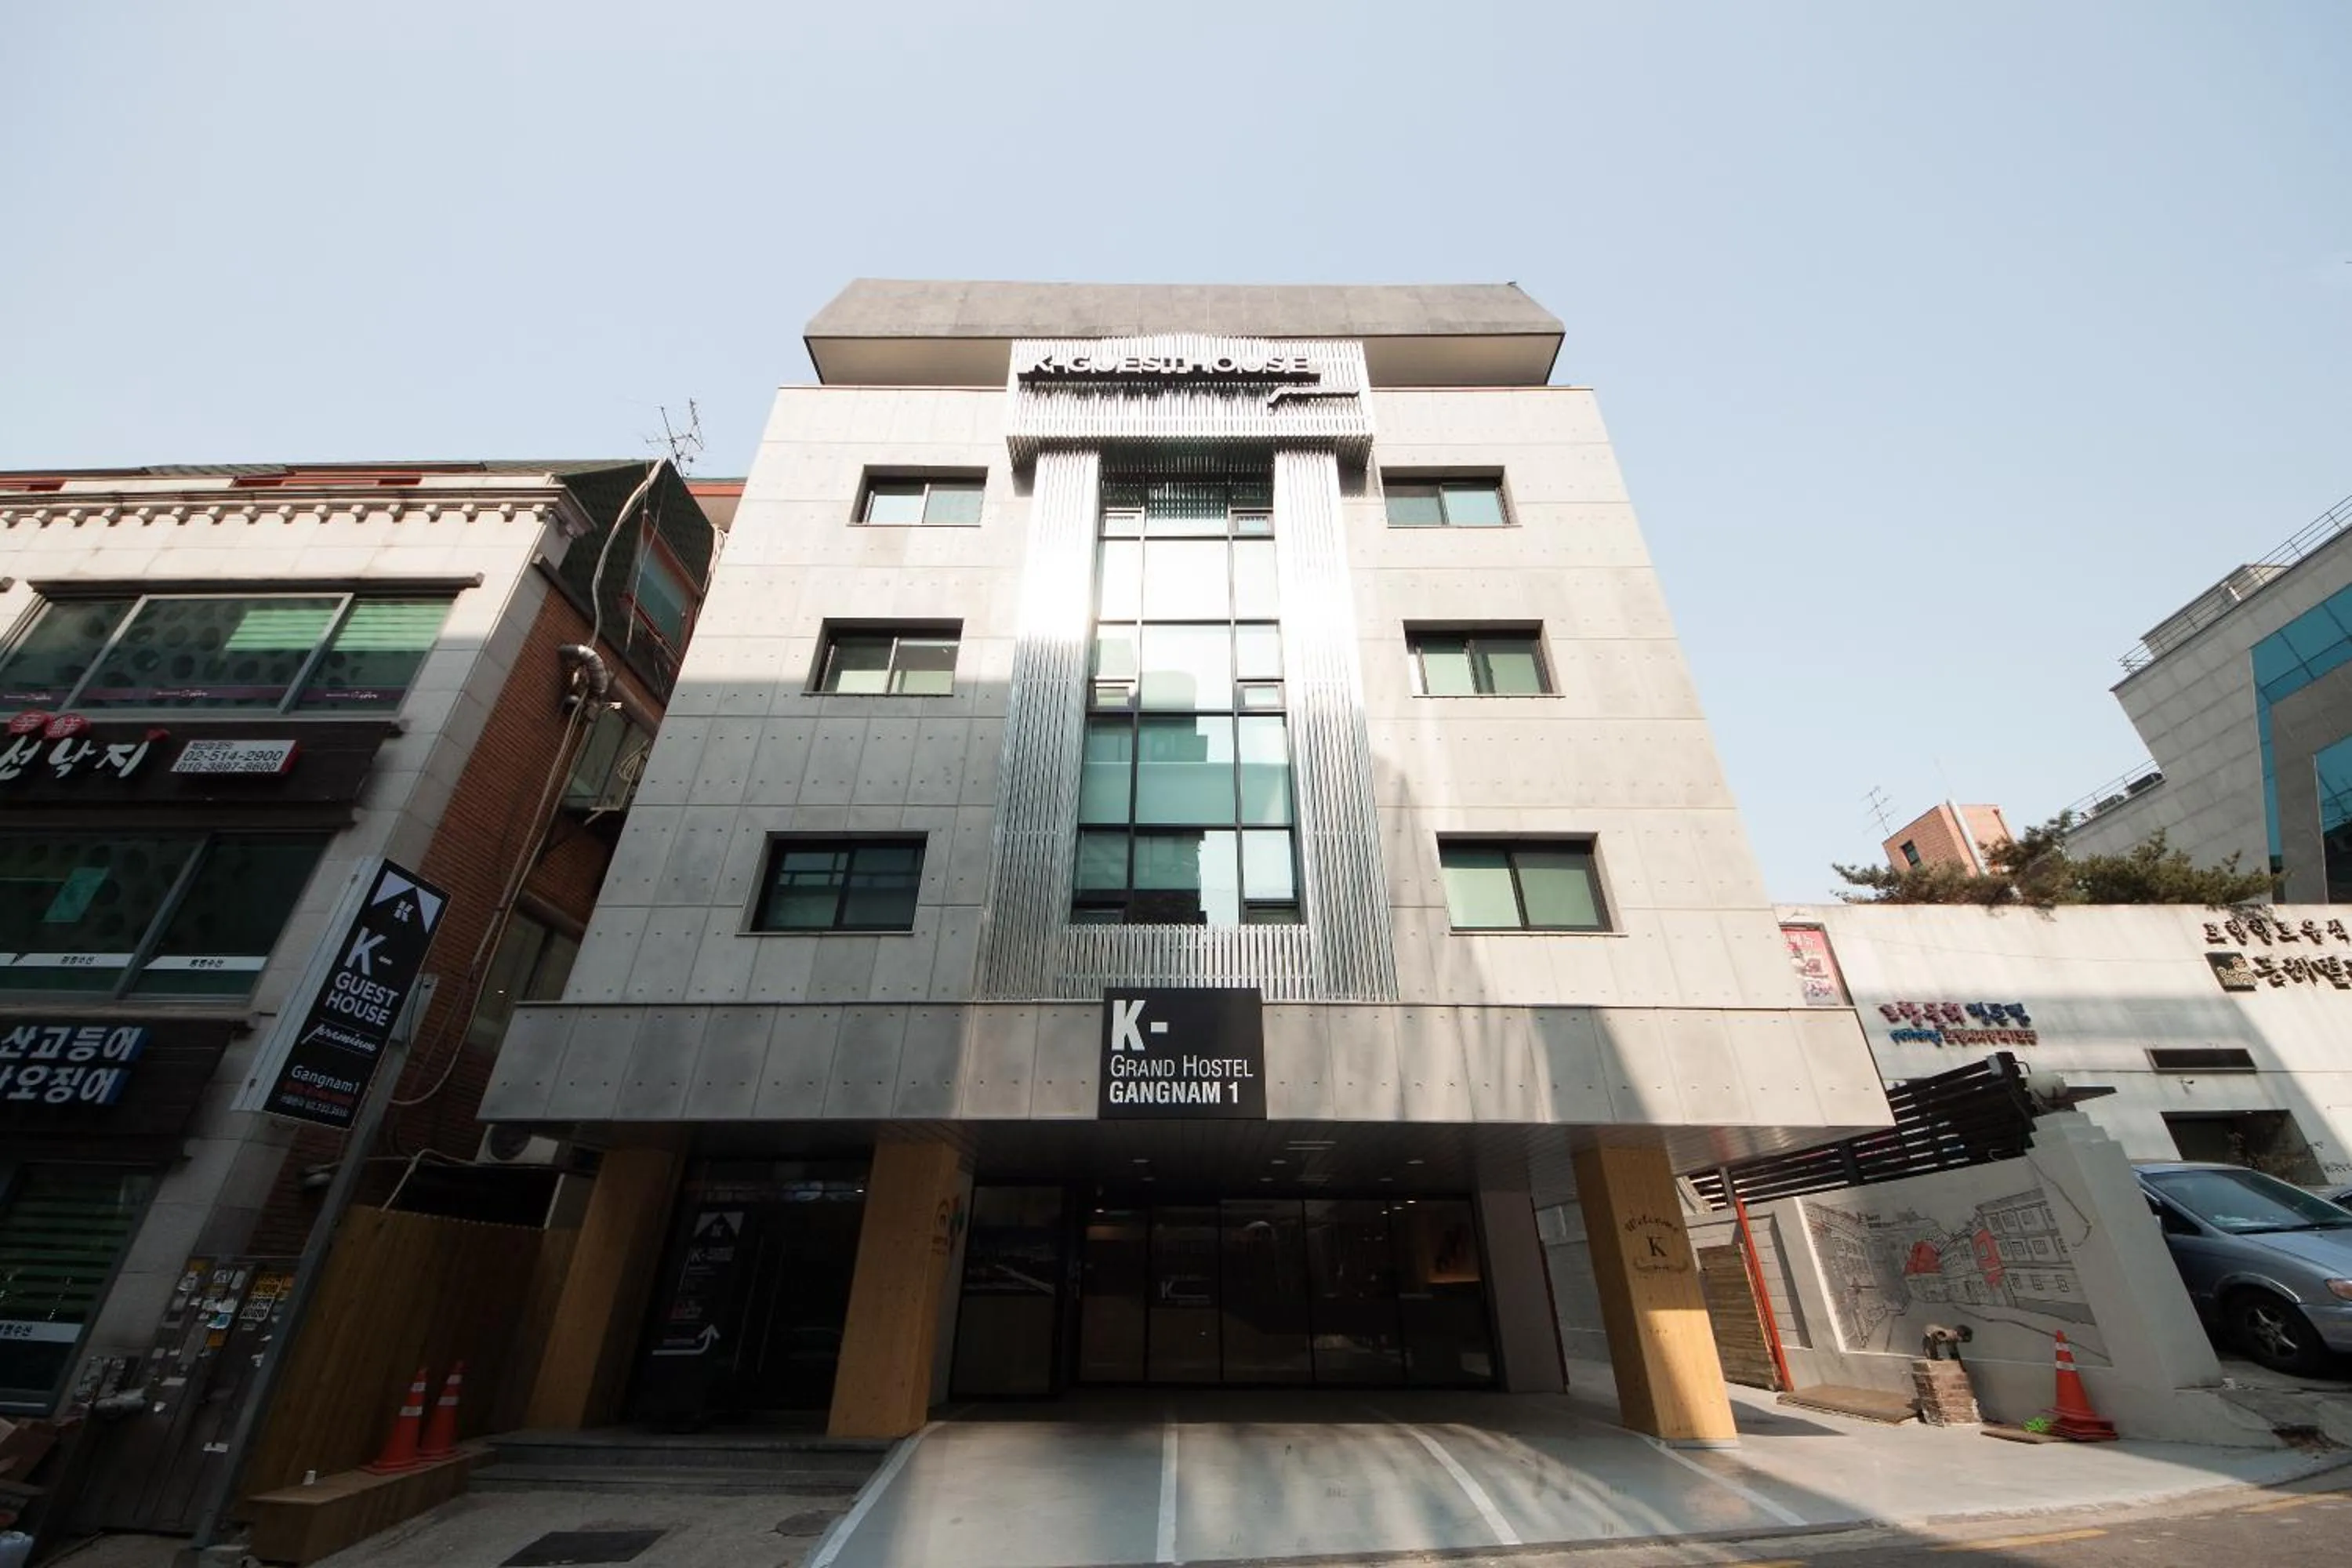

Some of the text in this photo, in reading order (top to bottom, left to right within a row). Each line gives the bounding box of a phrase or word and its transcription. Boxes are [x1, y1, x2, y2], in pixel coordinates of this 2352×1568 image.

[183, 750, 283, 761] 02-514-2900
[334, 971, 401, 1008] GUEST
[325, 989, 392, 1027] HOUSE
[1111, 999, 1169, 1051] K-
[1109, 1081, 1239, 1104] GANGNAM 1
[1647, 1236, 1668, 1257] K
